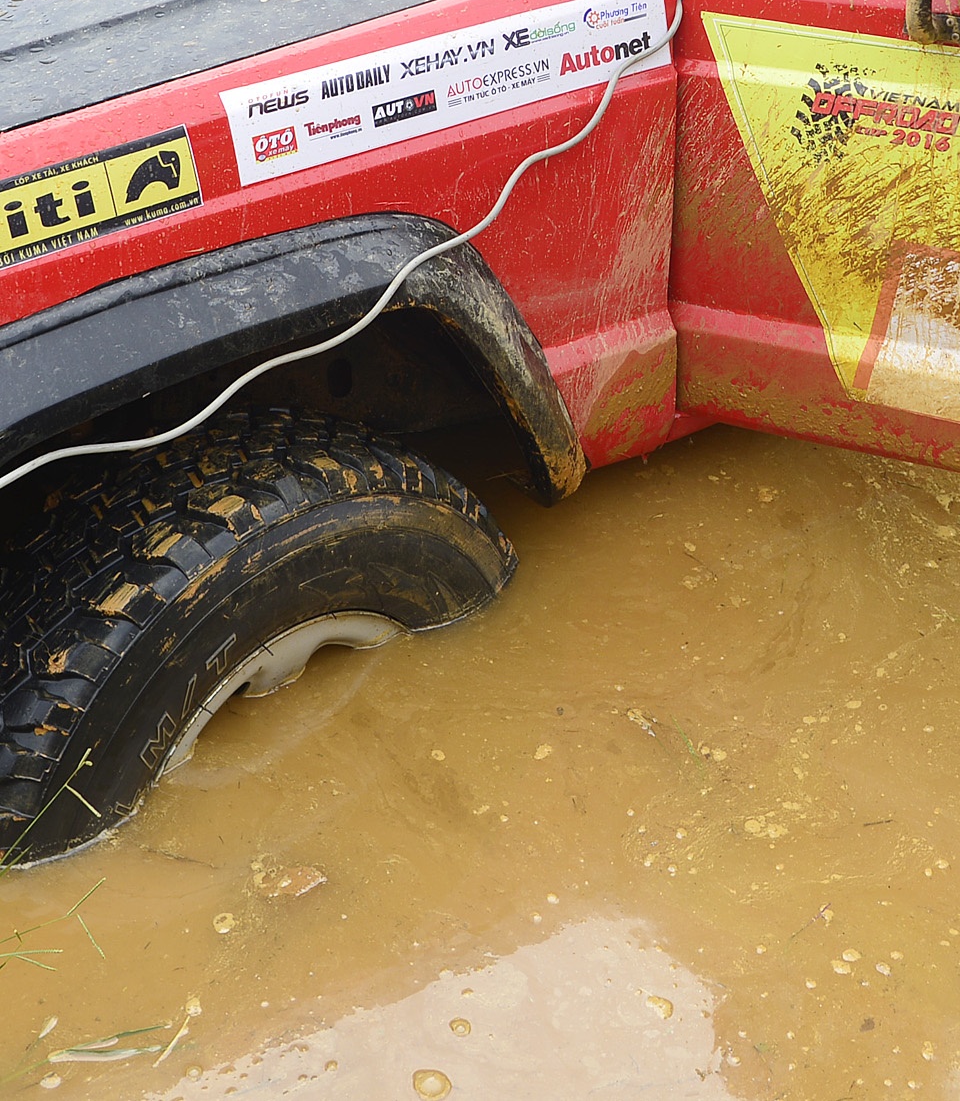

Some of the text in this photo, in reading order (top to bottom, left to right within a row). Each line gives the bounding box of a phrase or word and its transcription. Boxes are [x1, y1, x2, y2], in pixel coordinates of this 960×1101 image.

[600, 7, 628, 20] Phương
[502, 28, 531, 51] XE
[400, 38, 495, 80] XEHAY.VN
[559, 31, 651, 76] Autonet
[447, 58, 550, 97] AUTOEXPRESS.VN
[248, 89, 289, 103] OTOFUN
[463, 94, 475, 103] TIN
[511, 82, 520, 90] XE
[870, 89, 960, 113] VIETNAM
[890, 129, 951, 153] 2016
[31, 172, 42, 181] XE
[59, 164, 70, 173] XE
[71, 156, 99, 169] KHÁCH
[124, 197, 199, 227] www.kuma.com.vn
[18, 243, 48, 260] KUMA
[50, 234, 73, 249] VIỆT
[76, 227, 99, 242] NAM
